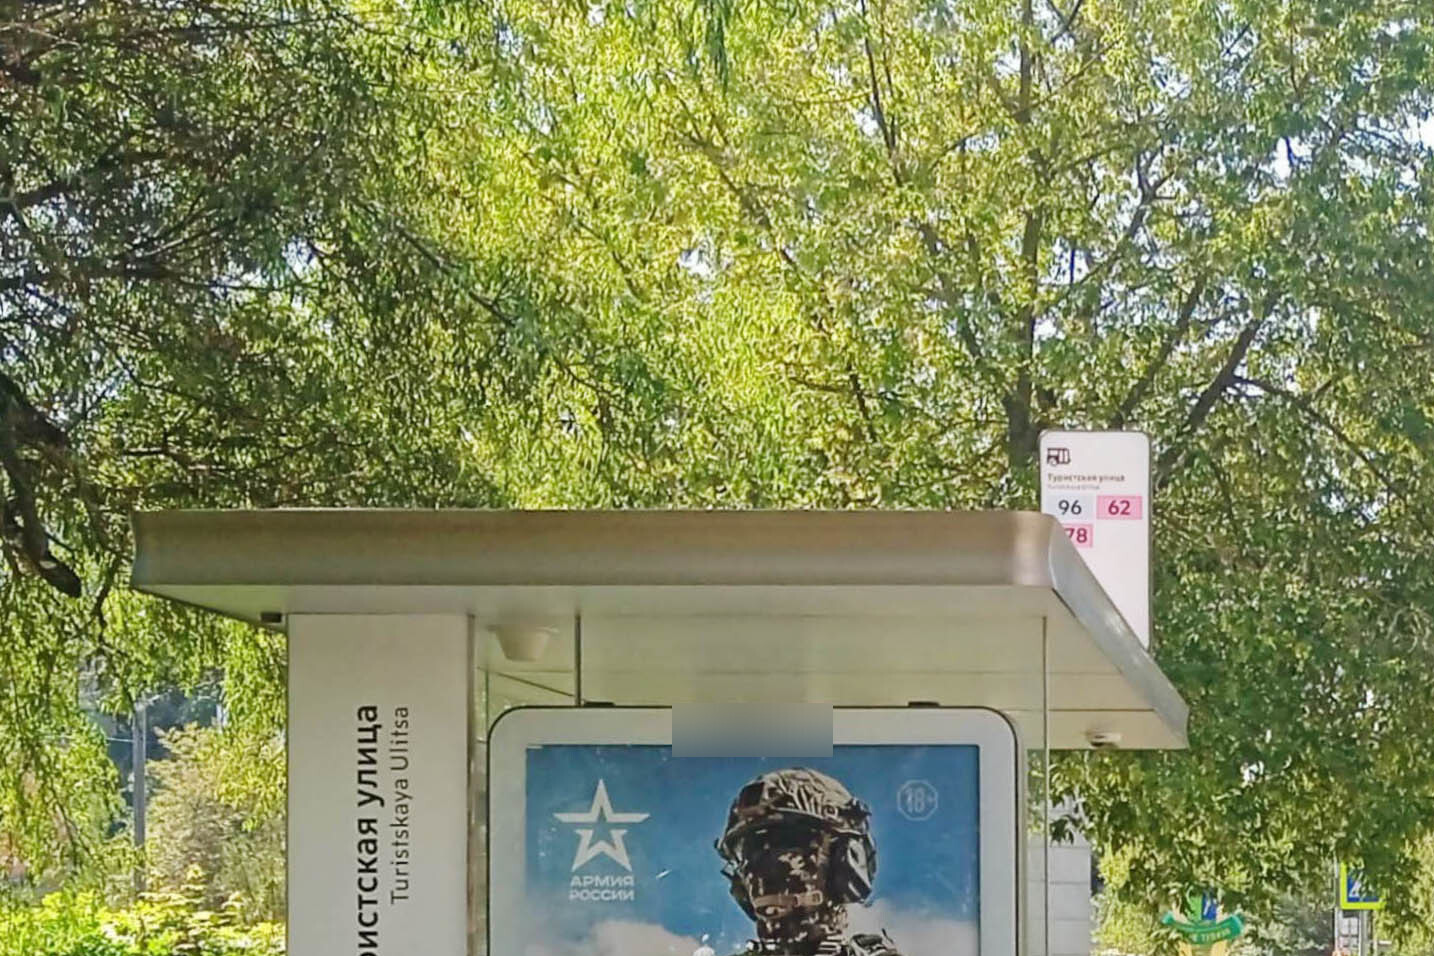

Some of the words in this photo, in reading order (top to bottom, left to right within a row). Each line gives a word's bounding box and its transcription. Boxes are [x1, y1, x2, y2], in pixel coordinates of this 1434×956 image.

[1058, 499, 1082, 516] 96
[1108, 499, 1131, 516] 62
[389, 706, 409, 771] Ulitsa
[357, 705, 385, 807] улица
[390, 778, 413, 904] Turistskaya
[570, 875, 635, 887] АРМИЯ
[568, 889, 635, 901] РОССИИ
